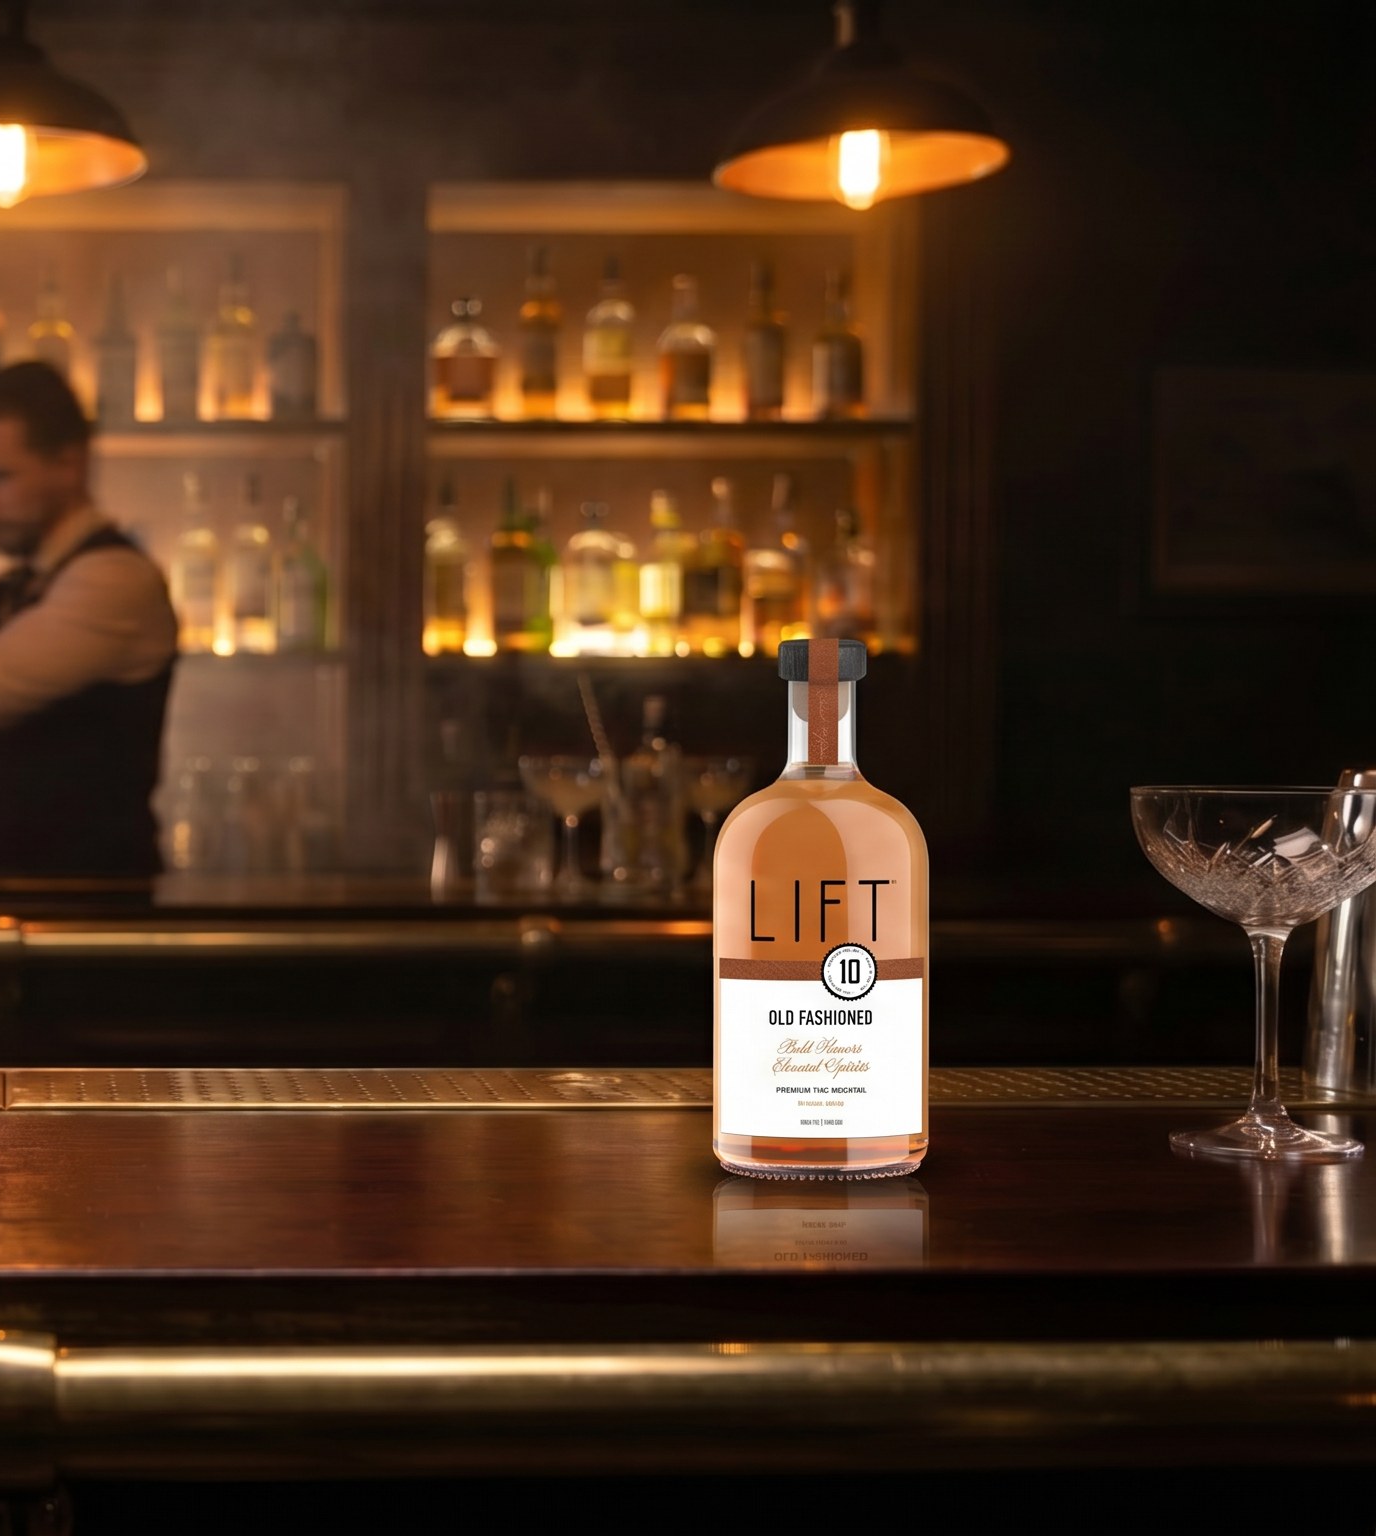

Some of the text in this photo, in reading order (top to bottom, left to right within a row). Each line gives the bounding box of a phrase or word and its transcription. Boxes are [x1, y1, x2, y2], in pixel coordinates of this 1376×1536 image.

[839, 958, 861, 985] 10
[768, 1009, 873, 1026] OLD FASHIONED
[775, 1086, 811, 1094] PREMIUM
